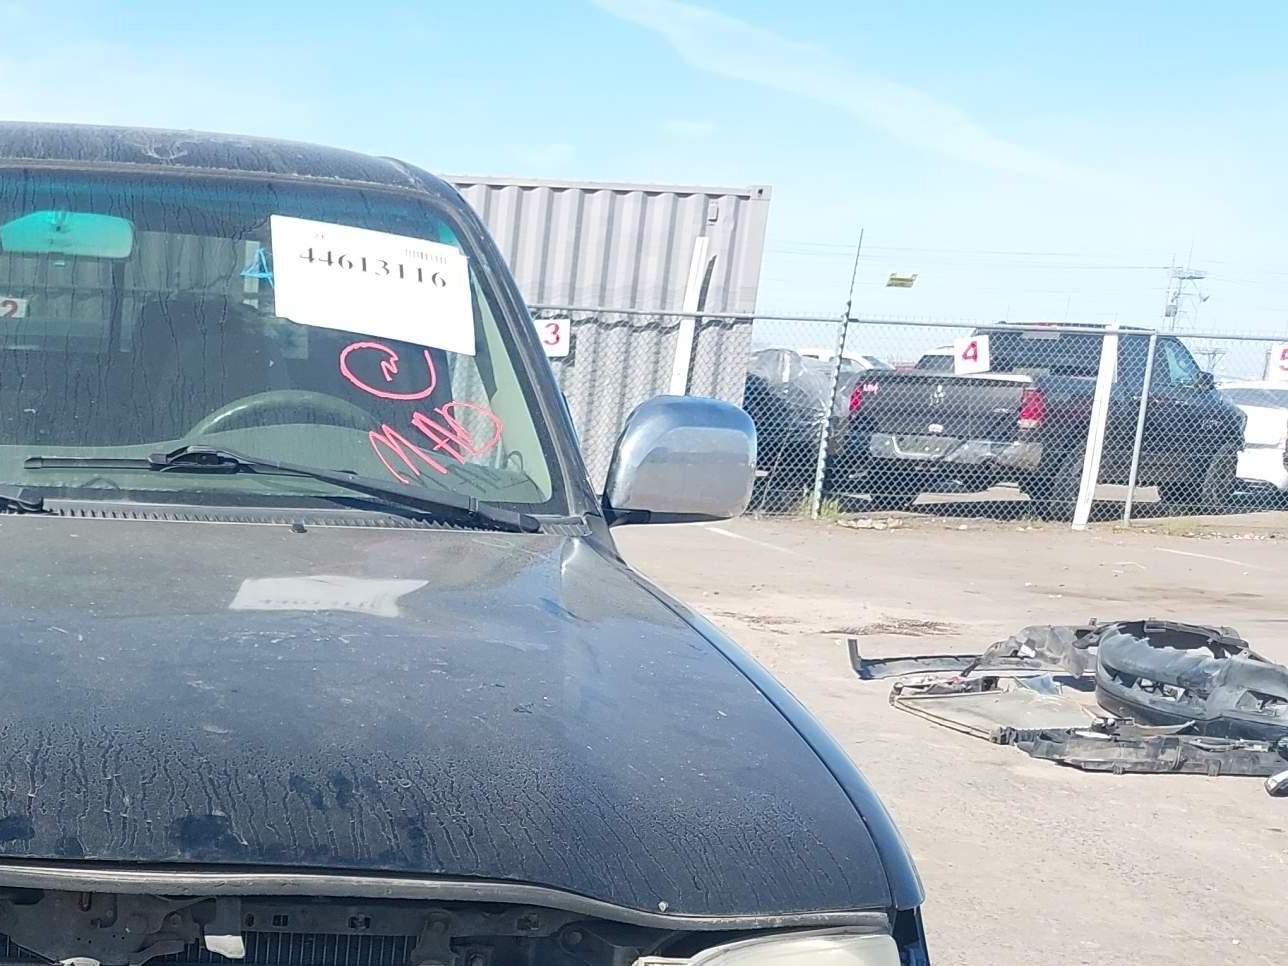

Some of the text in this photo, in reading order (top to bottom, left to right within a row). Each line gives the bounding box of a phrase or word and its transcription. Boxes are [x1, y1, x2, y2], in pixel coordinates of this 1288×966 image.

[298, 247, 447, 288] 44613116
[543, 322, 561, 346] 3
[961, 340, 978, 363] 4
